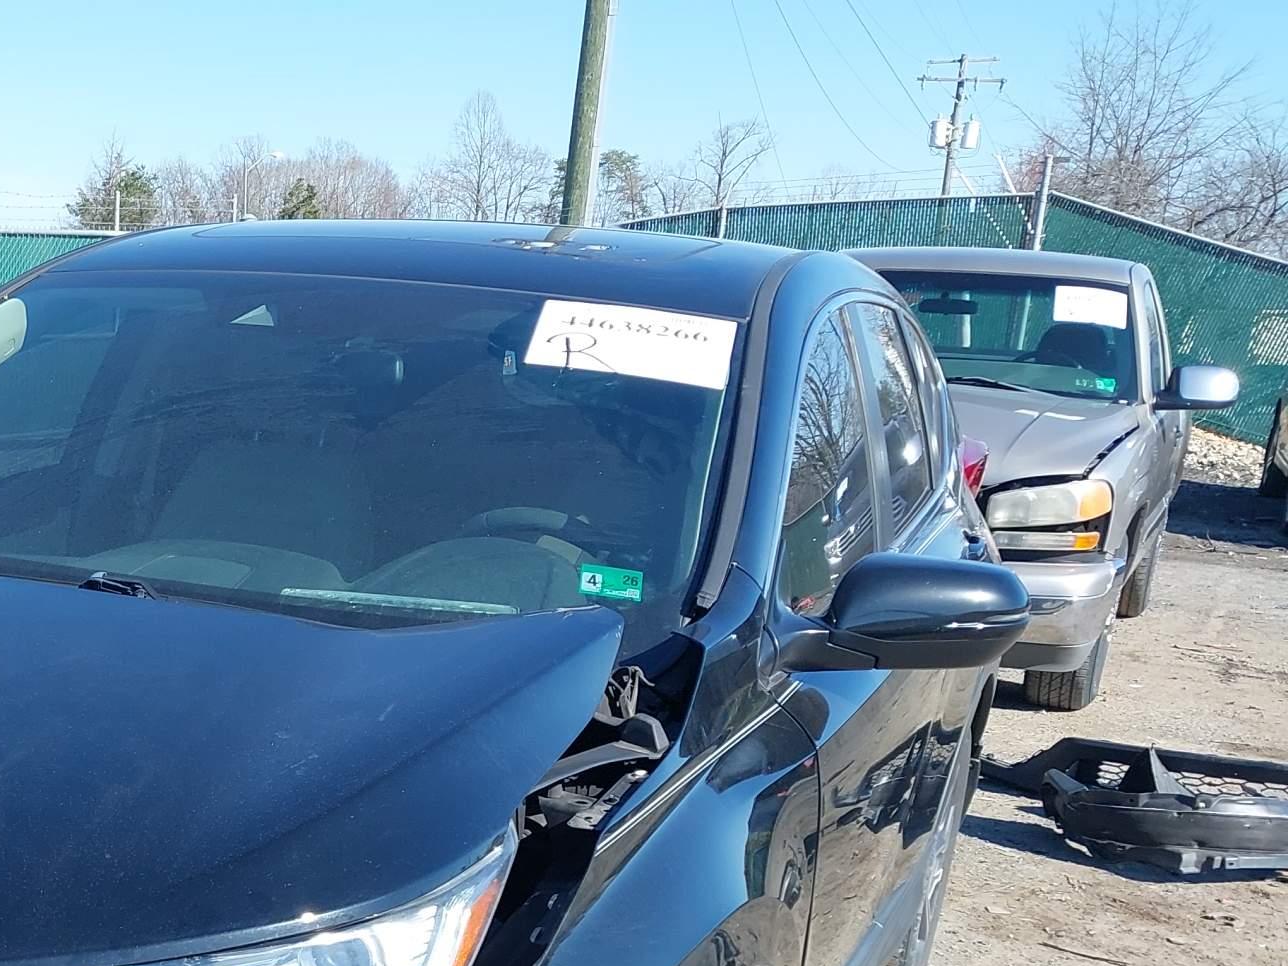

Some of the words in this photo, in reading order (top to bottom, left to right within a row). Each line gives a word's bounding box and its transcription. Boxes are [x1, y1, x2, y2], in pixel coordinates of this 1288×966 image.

[562, 315, 708, 342] 44638266
[546, 332, 618, 373] R
[586, 574, 600, 587] 4
[622, 574, 639, 587] 26
